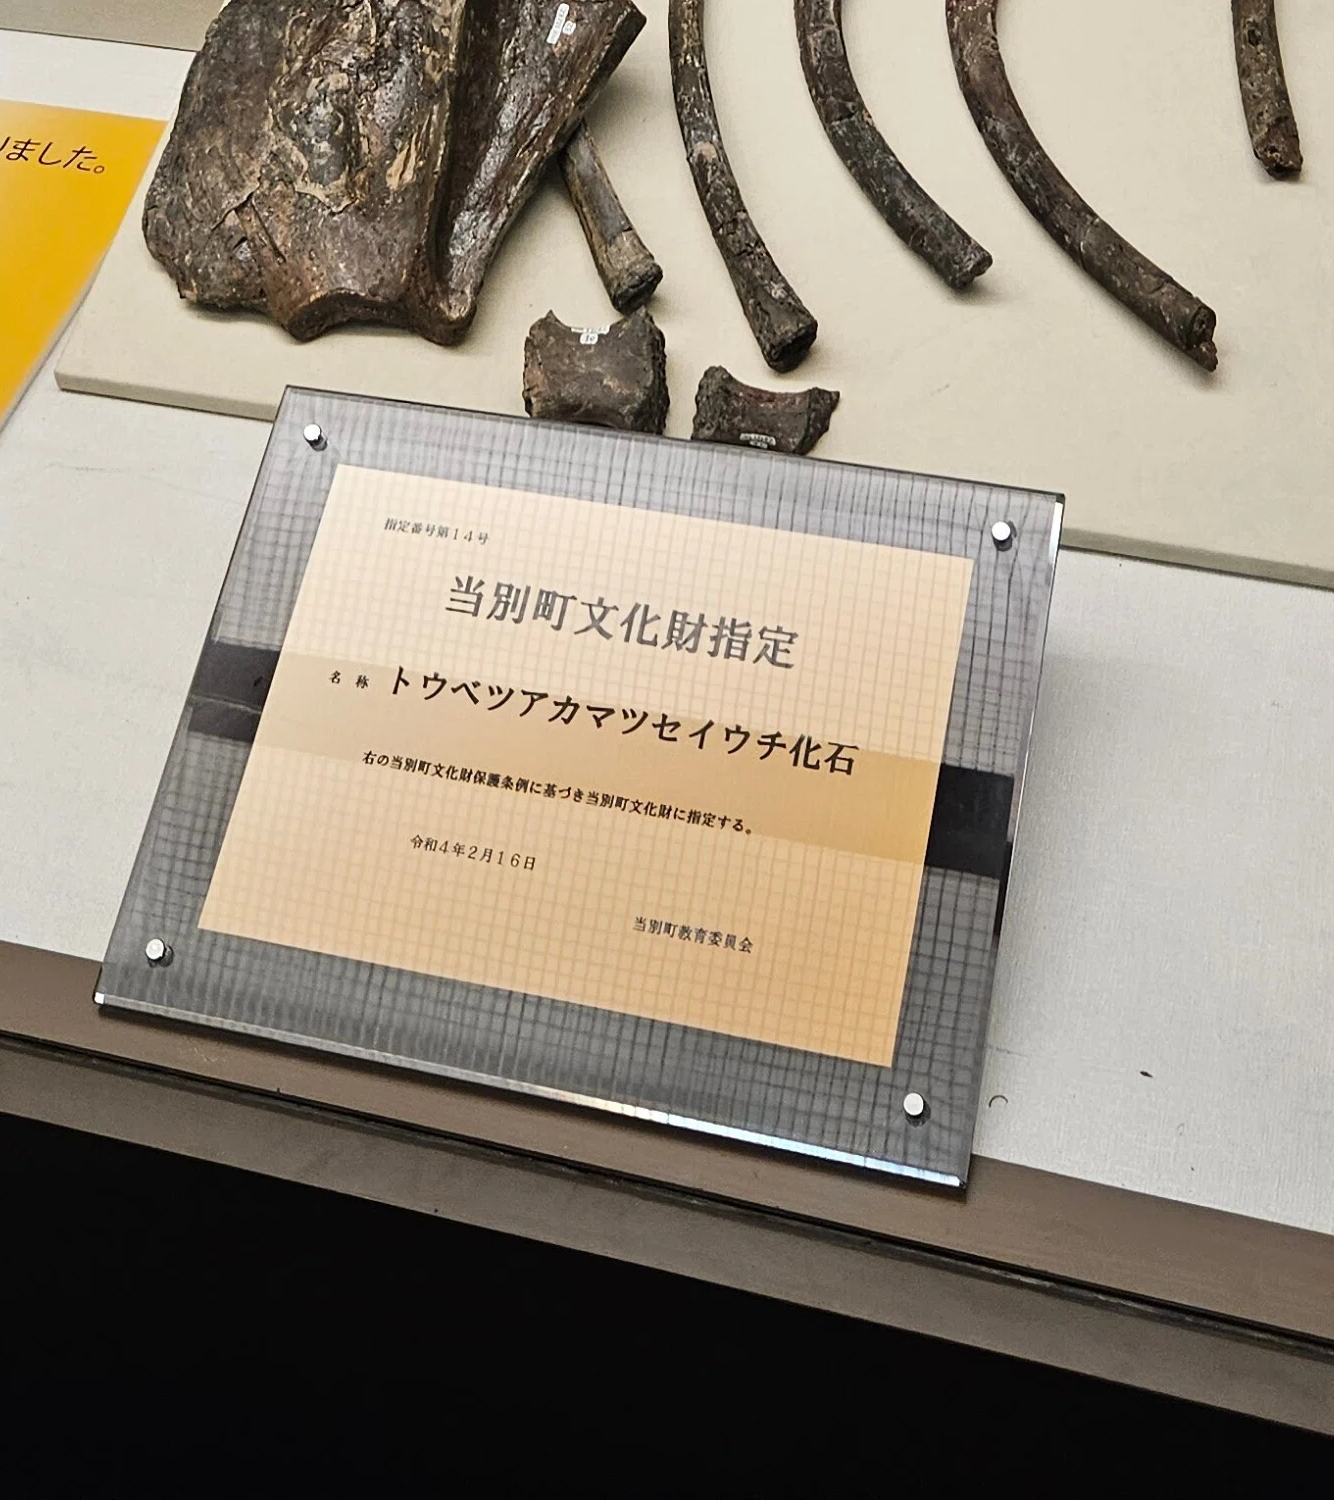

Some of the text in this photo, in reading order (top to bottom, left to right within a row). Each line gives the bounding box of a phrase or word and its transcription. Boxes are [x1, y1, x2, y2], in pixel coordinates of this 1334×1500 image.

[444, 574, 800, 670] 当別町文化財指定
[390, 664, 860, 776] トウベツアカマツセイウチ化石
[362, 750, 753, 836] 右の当別町文化財保護条例に基づき当別町文化財に指定する。
[409, 833, 537, 872] 令和4年2月16日
[633, 915, 755, 956] 当別町教育委員会
